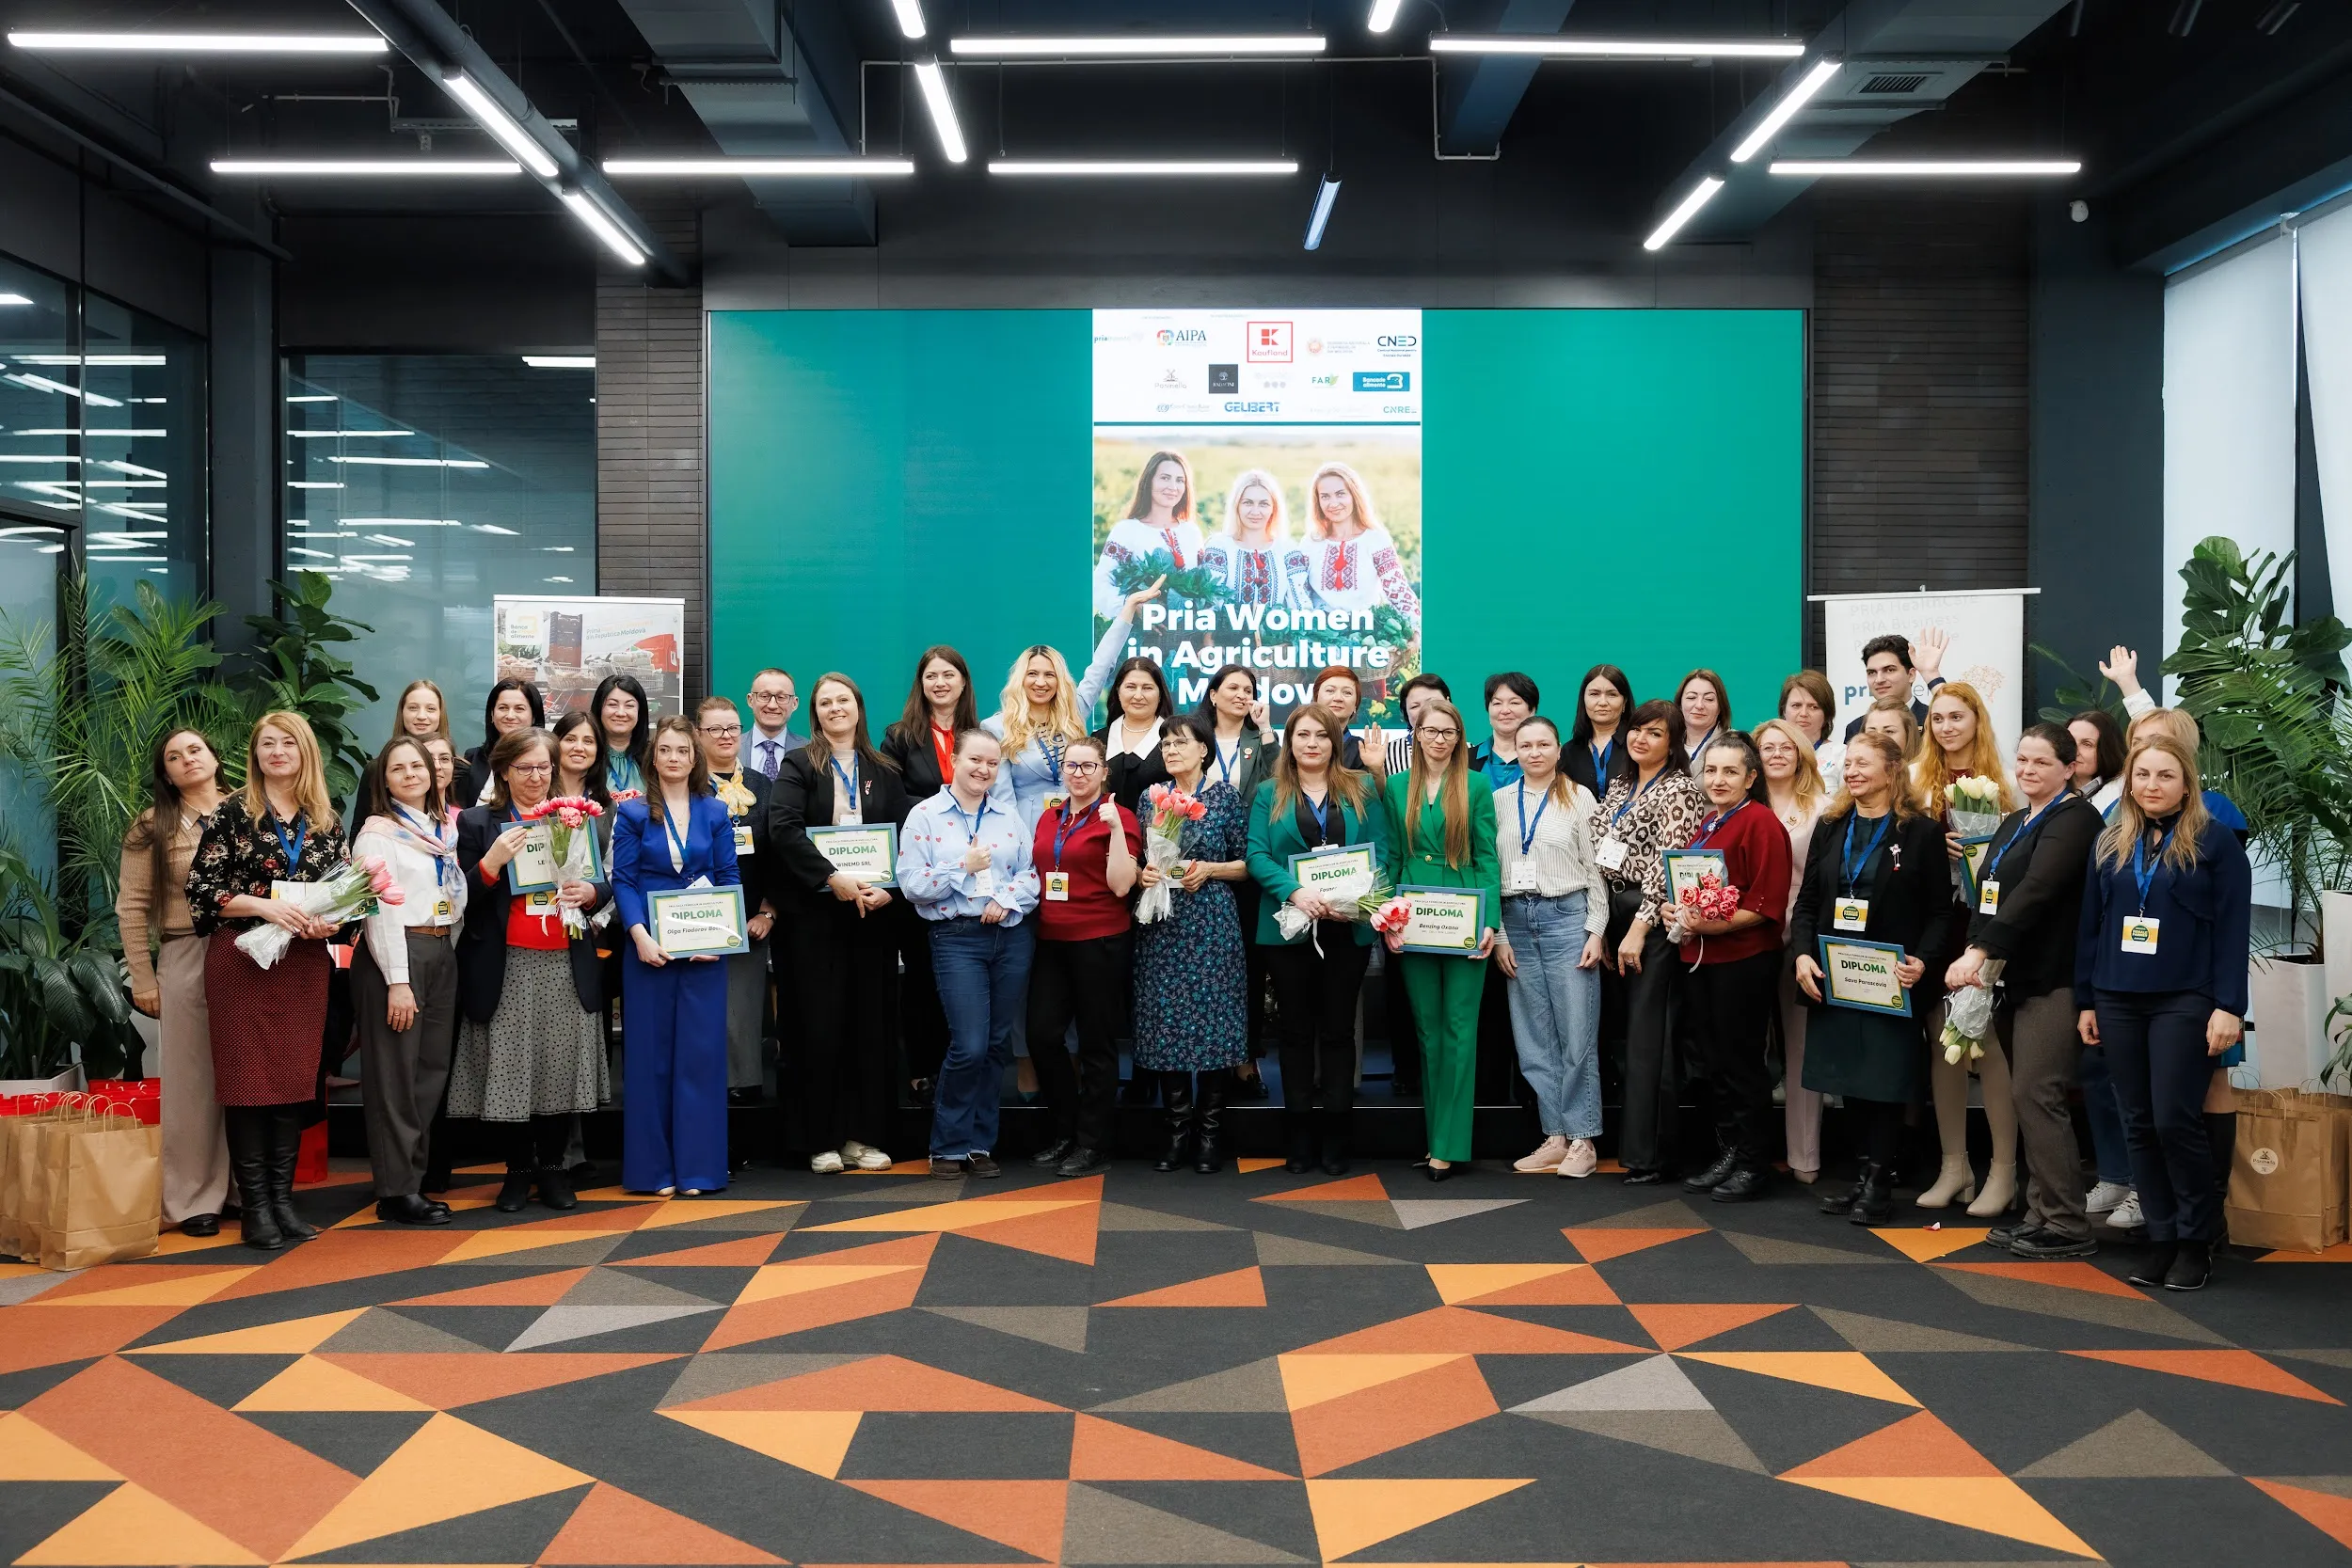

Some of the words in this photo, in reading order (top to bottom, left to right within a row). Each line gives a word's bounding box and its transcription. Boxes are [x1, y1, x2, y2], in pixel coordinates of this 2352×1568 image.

[1176, 330, 1207, 341] AIPA
[1377, 336, 1417, 347] CNED
[1224, 402, 1280, 413] GELIBERT
[1142, 600, 1216, 631] Pria
[1225, 603, 1375, 631] Women
[1892, 615, 1960, 630] Business
[1128, 638, 1163, 667] in
[1171, 638, 1391, 675] Agriculture
[829, 846, 877, 856] DIPLOMA
[1311, 866, 1358, 881] DIPLOMA
[671, 909, 723, 921] DIPLOMA
[1416, 907, 1464, 918] DIPLOMA
[1840, 959, 1887, 974] DIPLOMA
